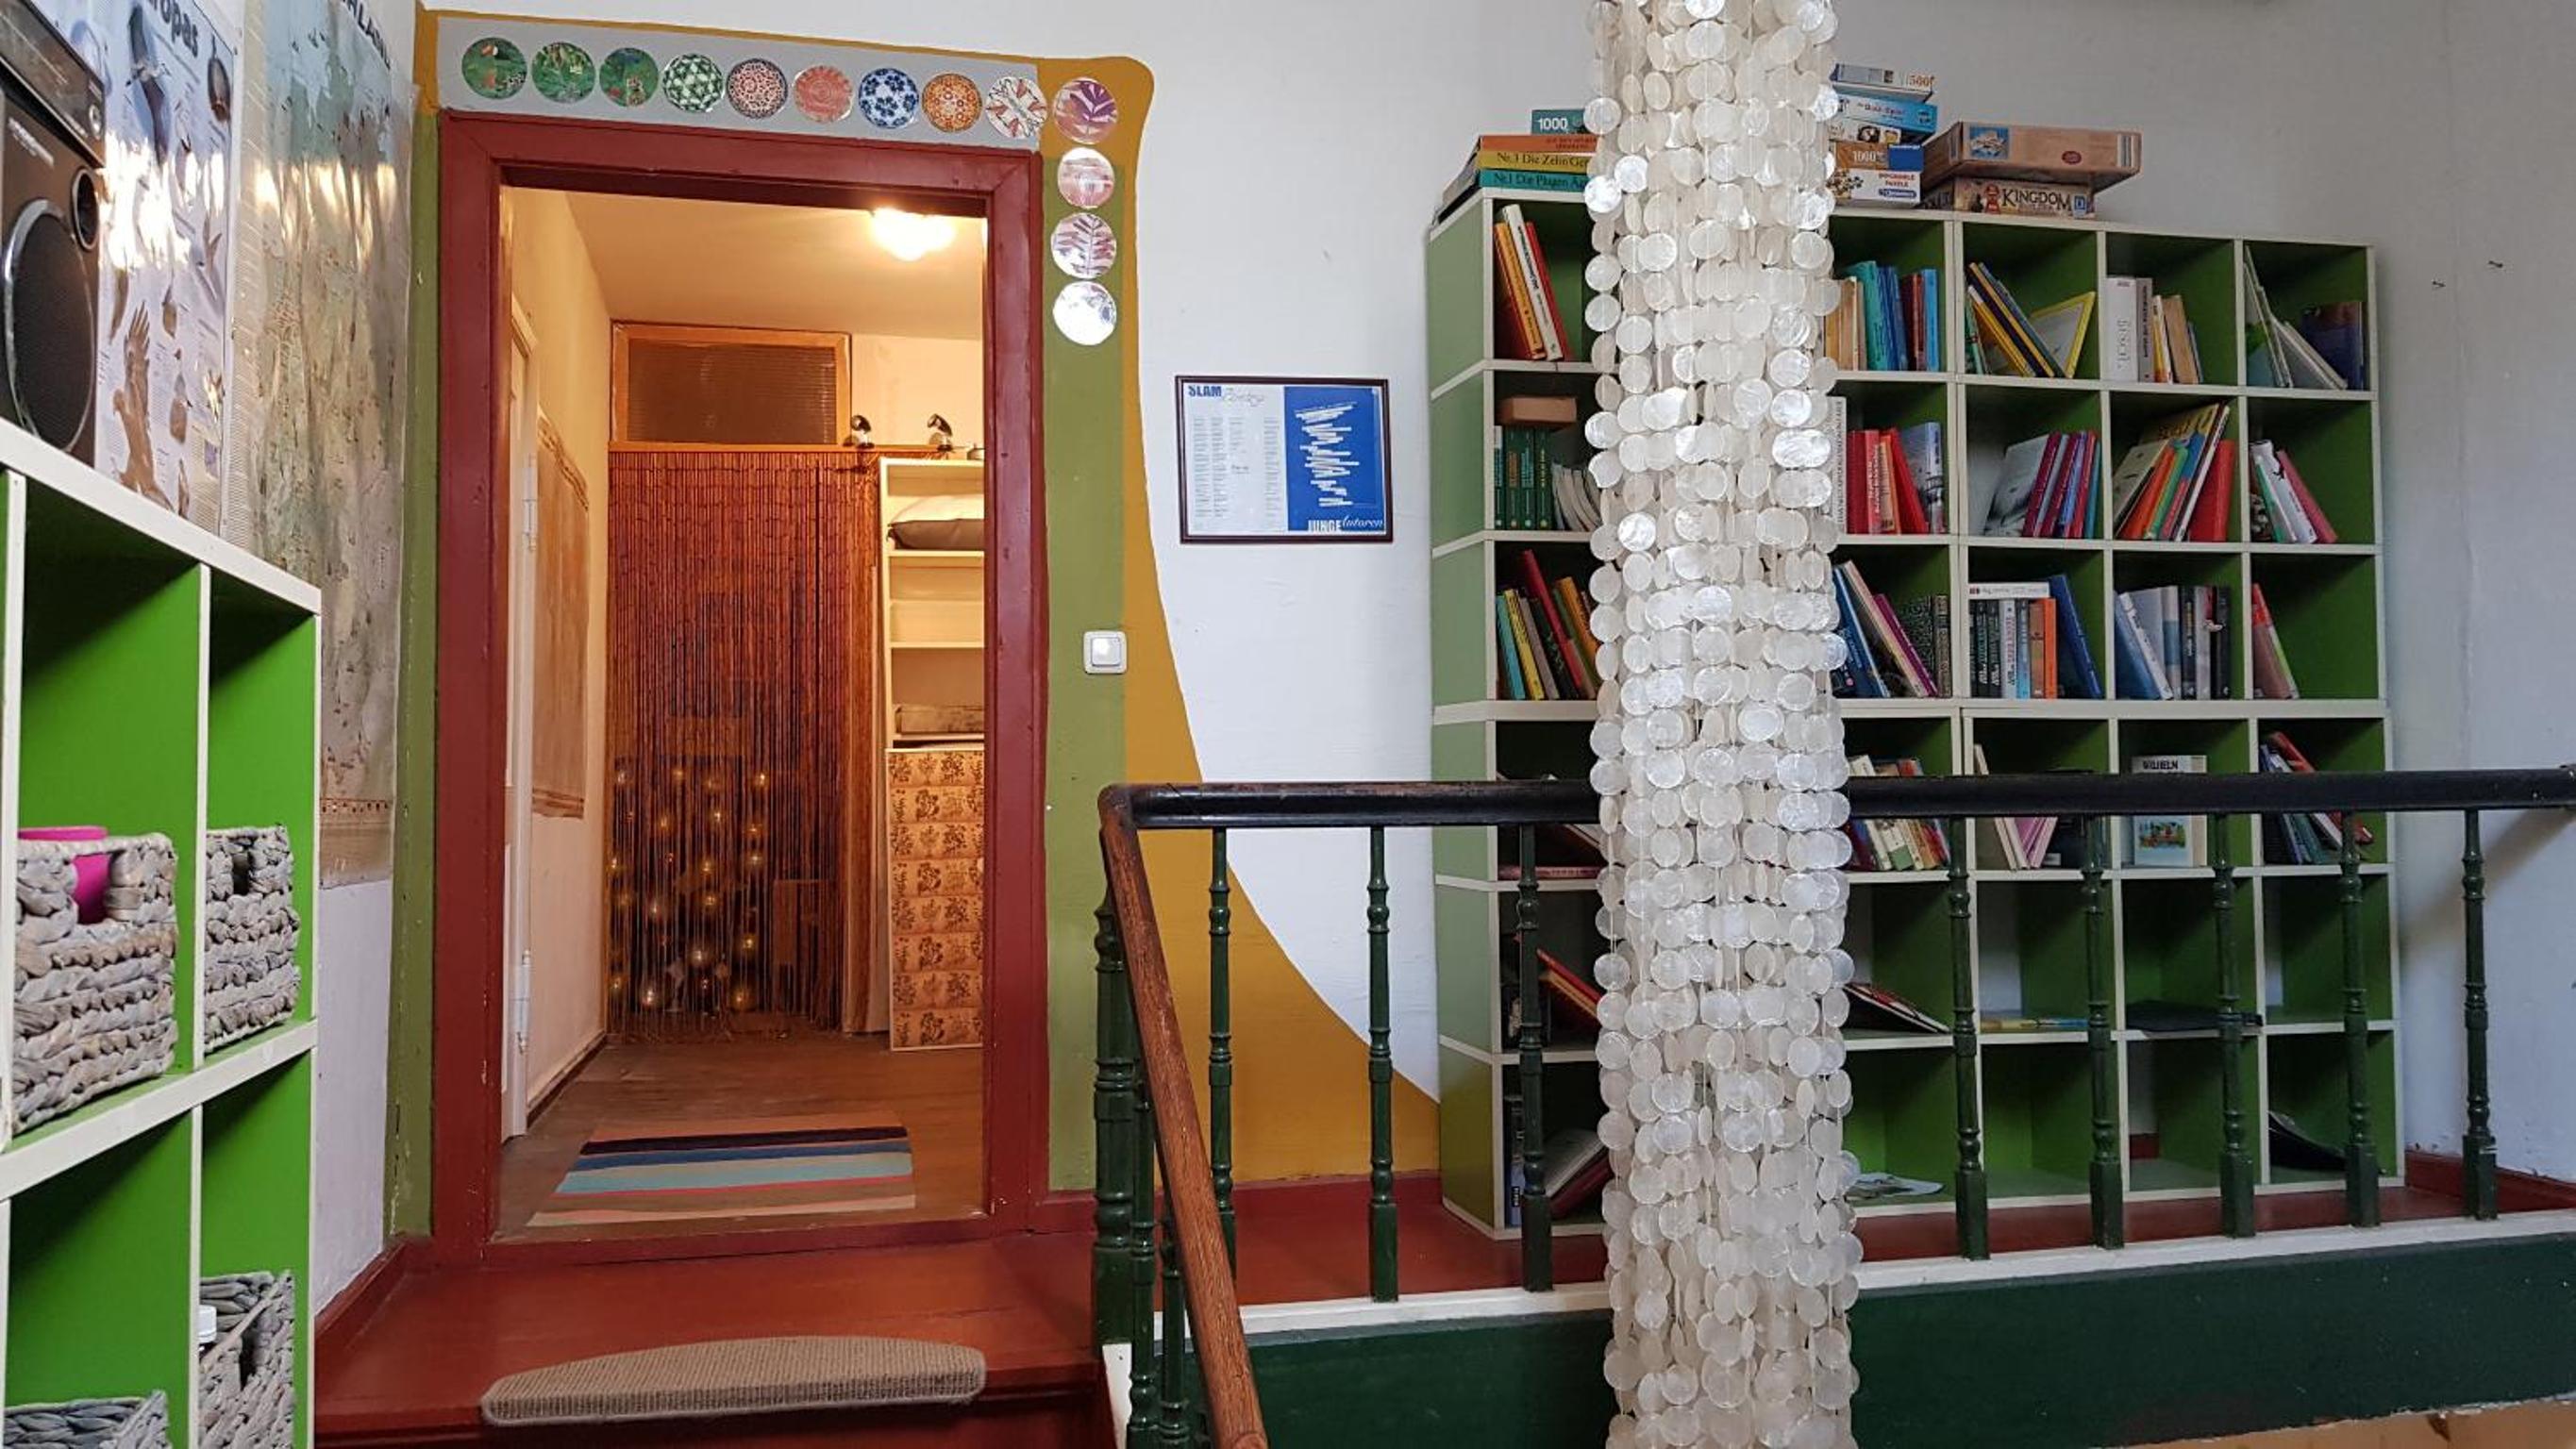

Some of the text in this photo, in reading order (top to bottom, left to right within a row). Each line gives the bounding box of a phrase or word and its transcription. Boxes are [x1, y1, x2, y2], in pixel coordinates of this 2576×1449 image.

[1538, 117, 1568, 130] 1000
[1522, 153, 1540, 164] Die
[2001, 188, 2071, 211] KINGDOM
[1188, 386, 1222, 397] SLAM
[1308, 520, 1341, 532] JUNGE
